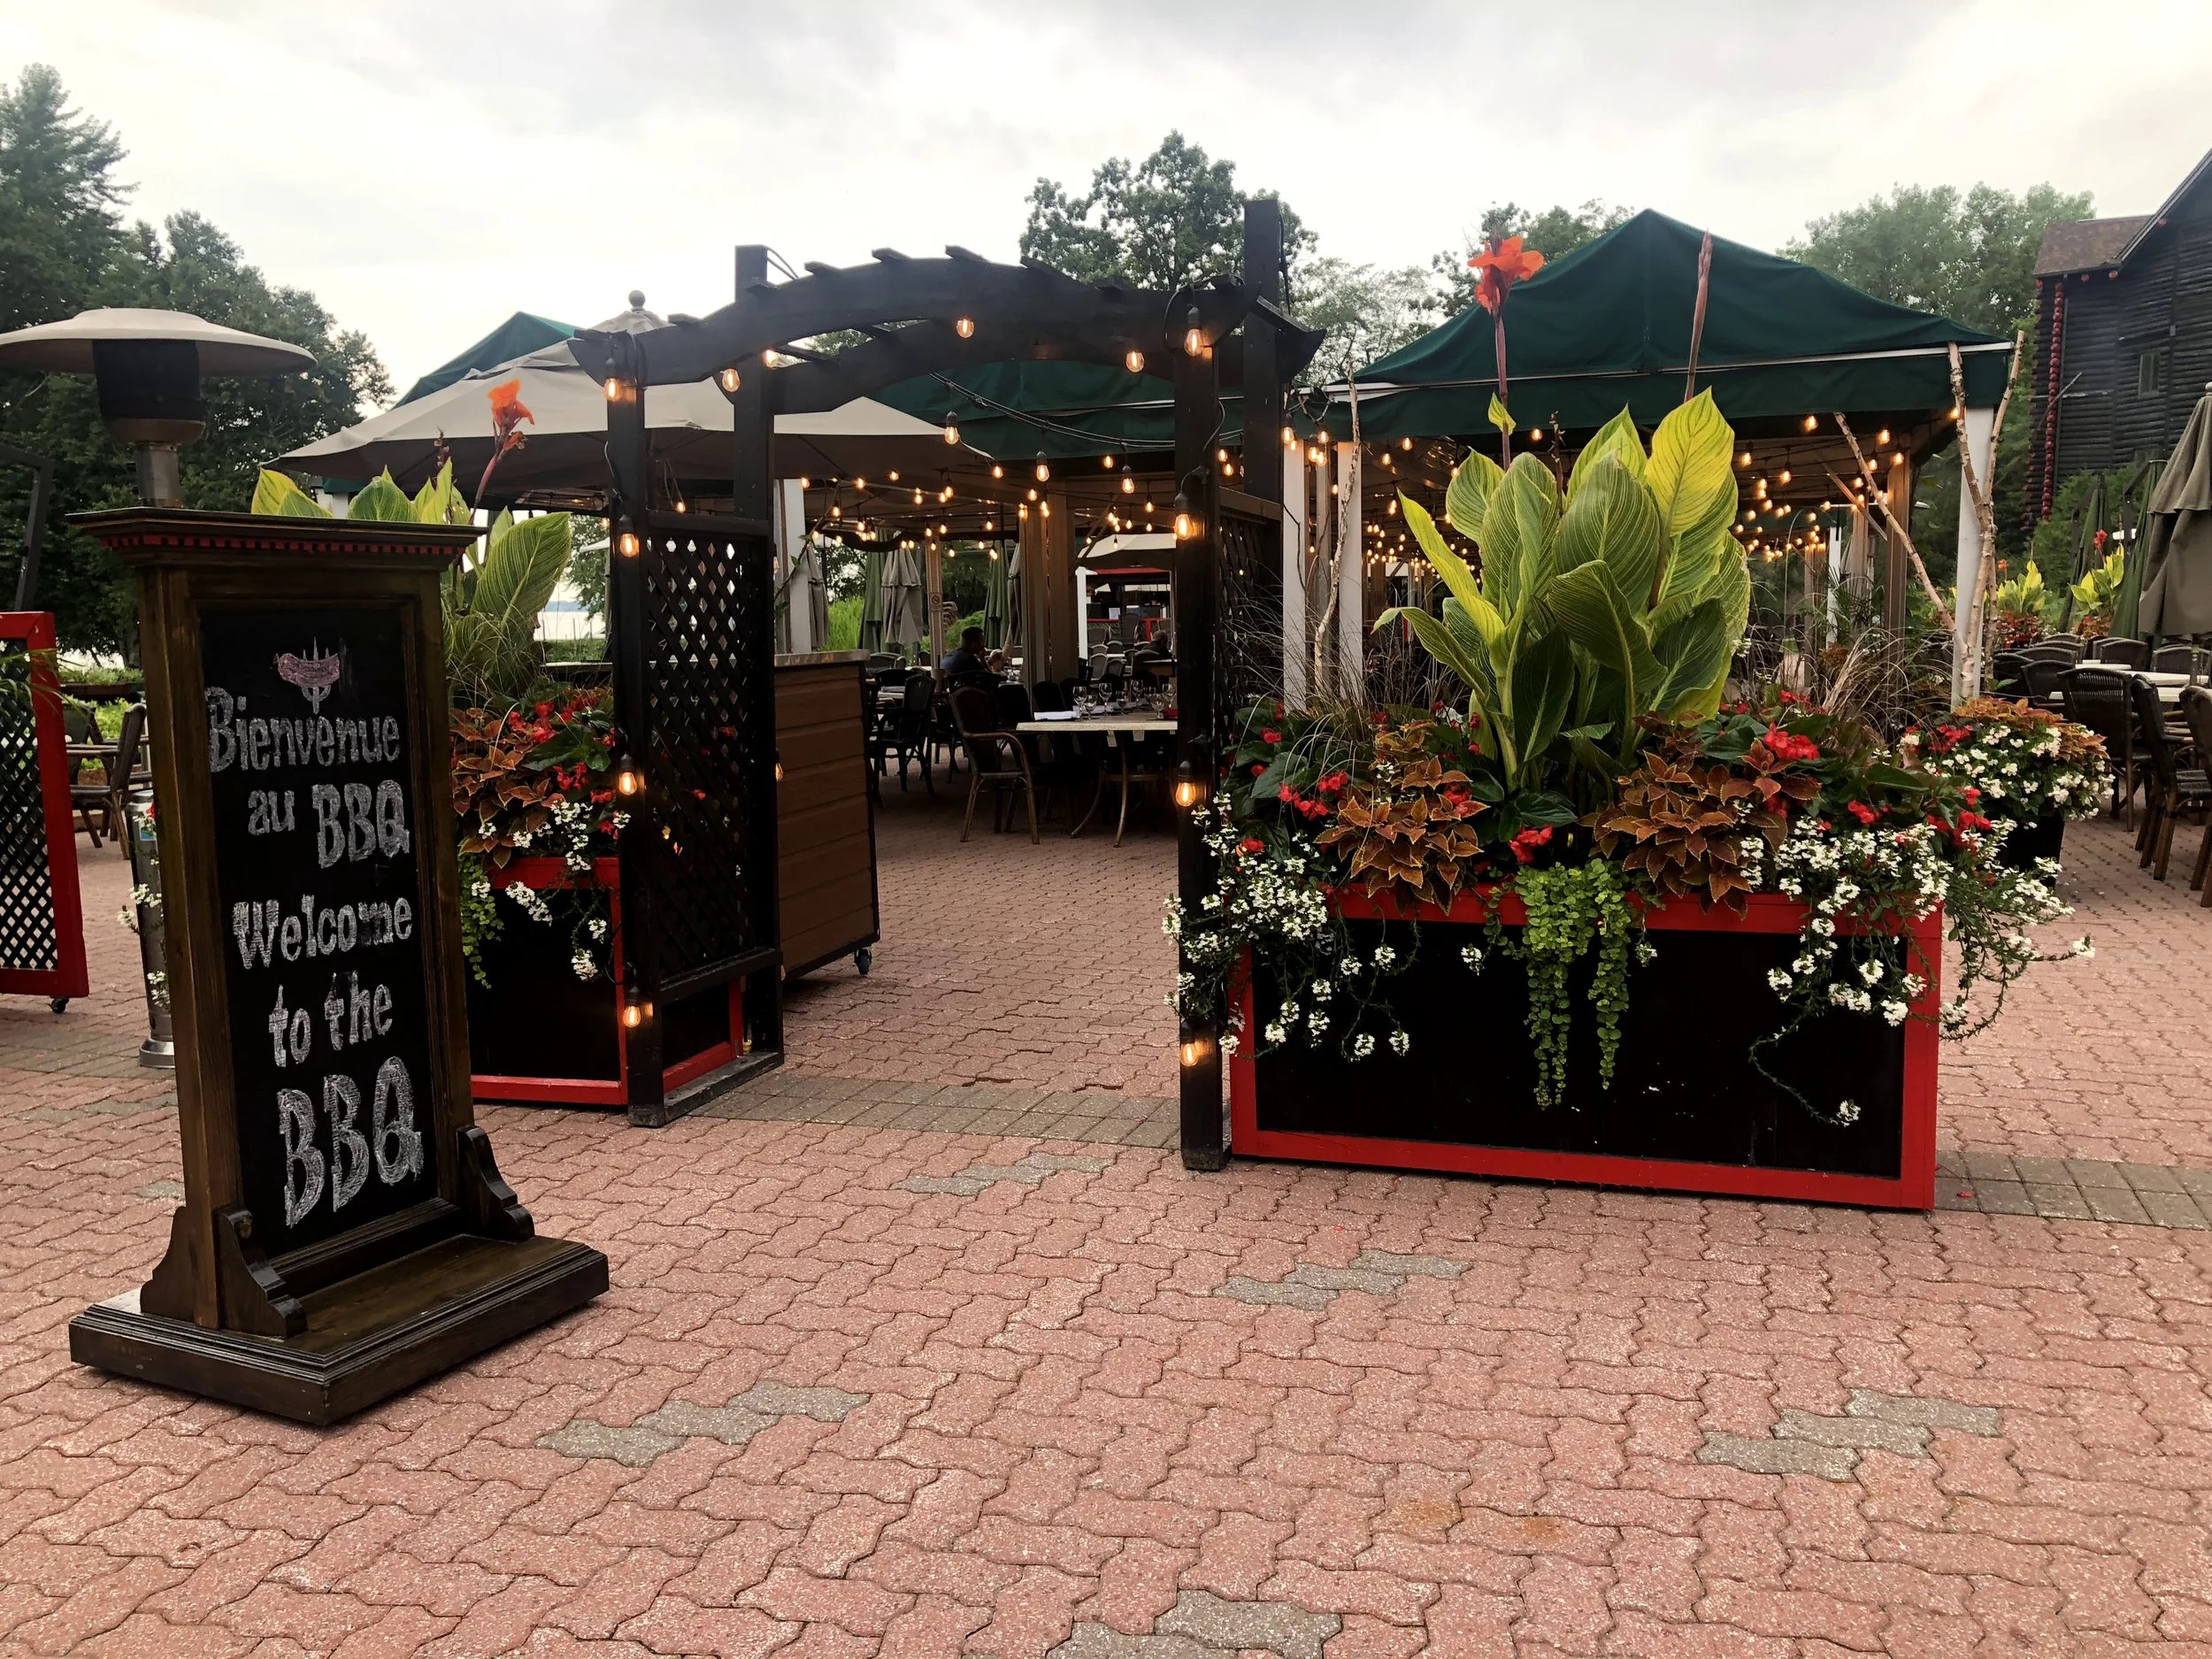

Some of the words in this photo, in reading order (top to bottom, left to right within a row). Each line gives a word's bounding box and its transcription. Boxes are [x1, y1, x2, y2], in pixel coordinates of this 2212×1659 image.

[204, 687, 399, 772] Bienvenue
[248, 789, 295, 835] au
[311, 780, 410, 868] BBQ
[232, 895, 412, 969] Welcome
[268, 984, 311, 1067] to
[324, 971, 393, 1050] the
[276, 1056, 425, 1228] BBQ
